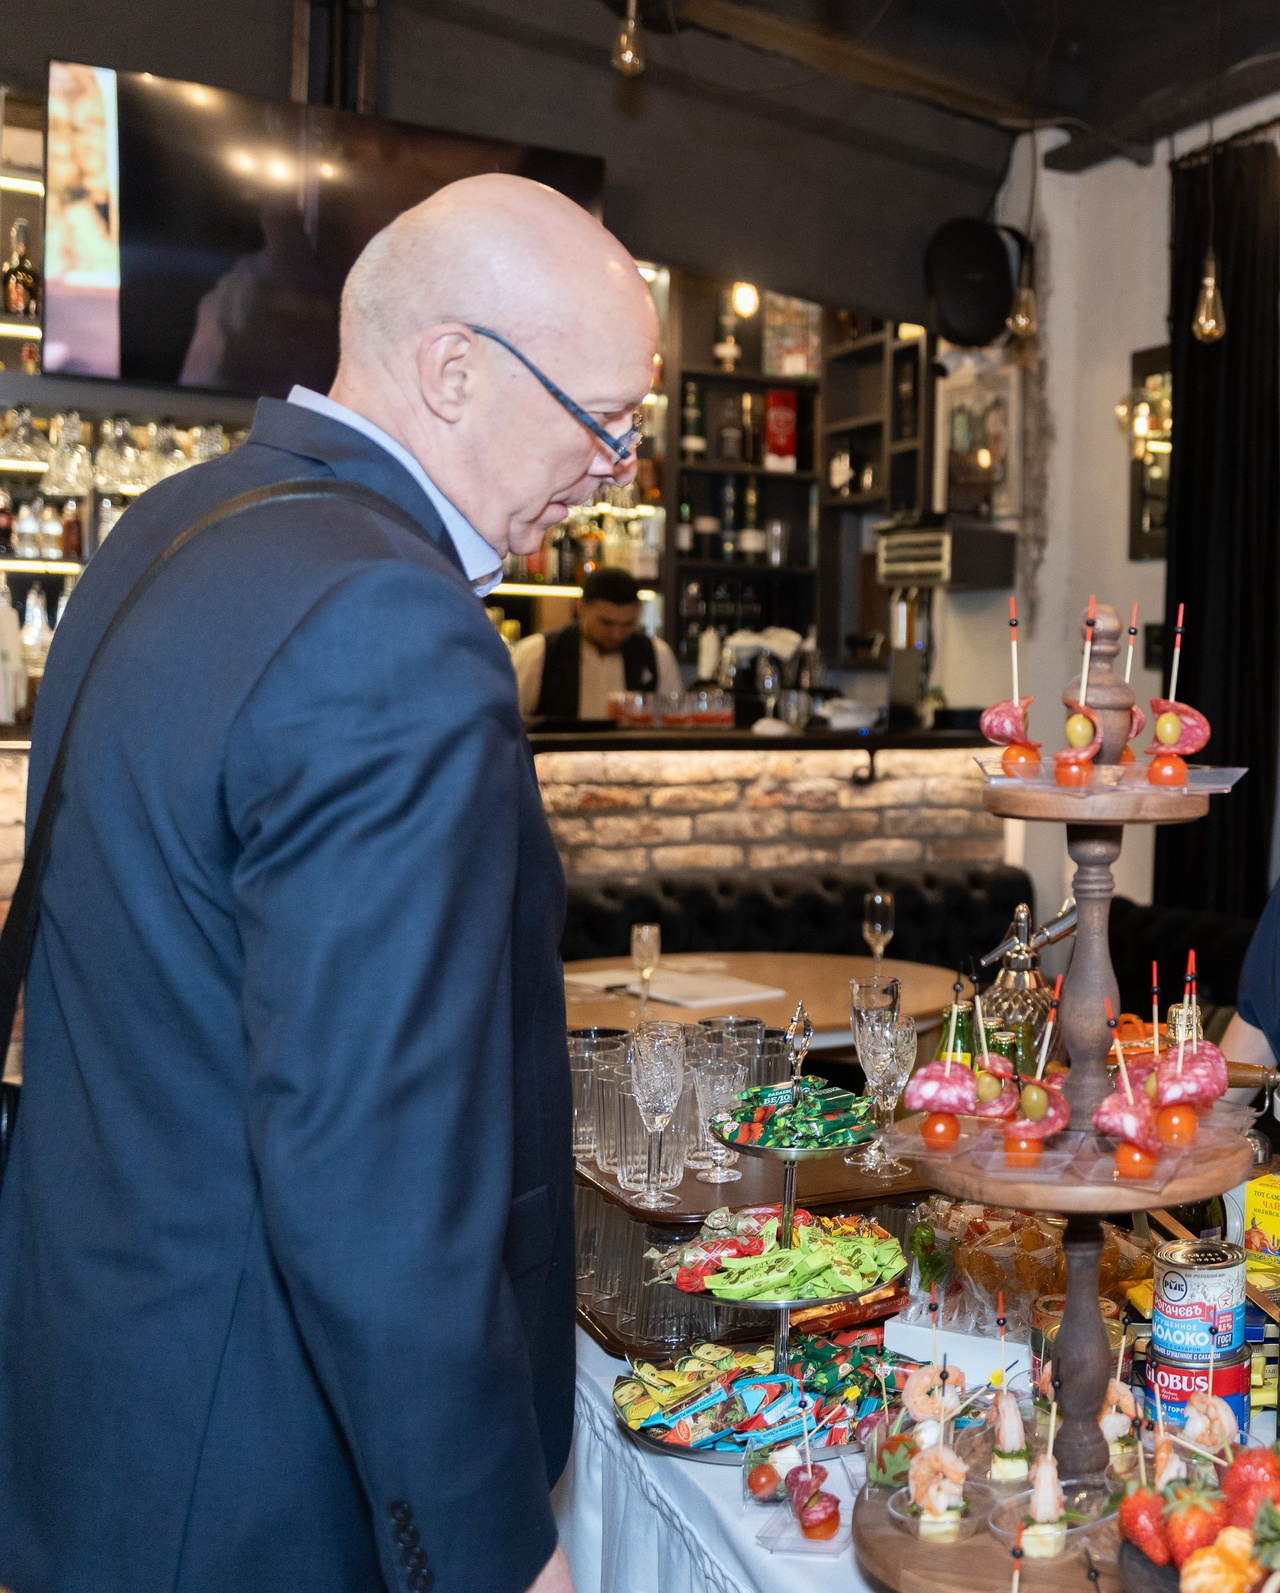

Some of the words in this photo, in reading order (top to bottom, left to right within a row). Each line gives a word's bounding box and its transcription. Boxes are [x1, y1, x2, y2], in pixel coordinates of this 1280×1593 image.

[1254, 1190, 1265, 1198] ТОТ
[1263, 1201, 1280, 1210] ЧАЙ
[1155, 1315, 1198, 1331] СГУЩЕННОЕ
[1217, 1334, 1232, 1344] ГОСТ
[1145, 1363, 1209, 1392] GLOBUS
